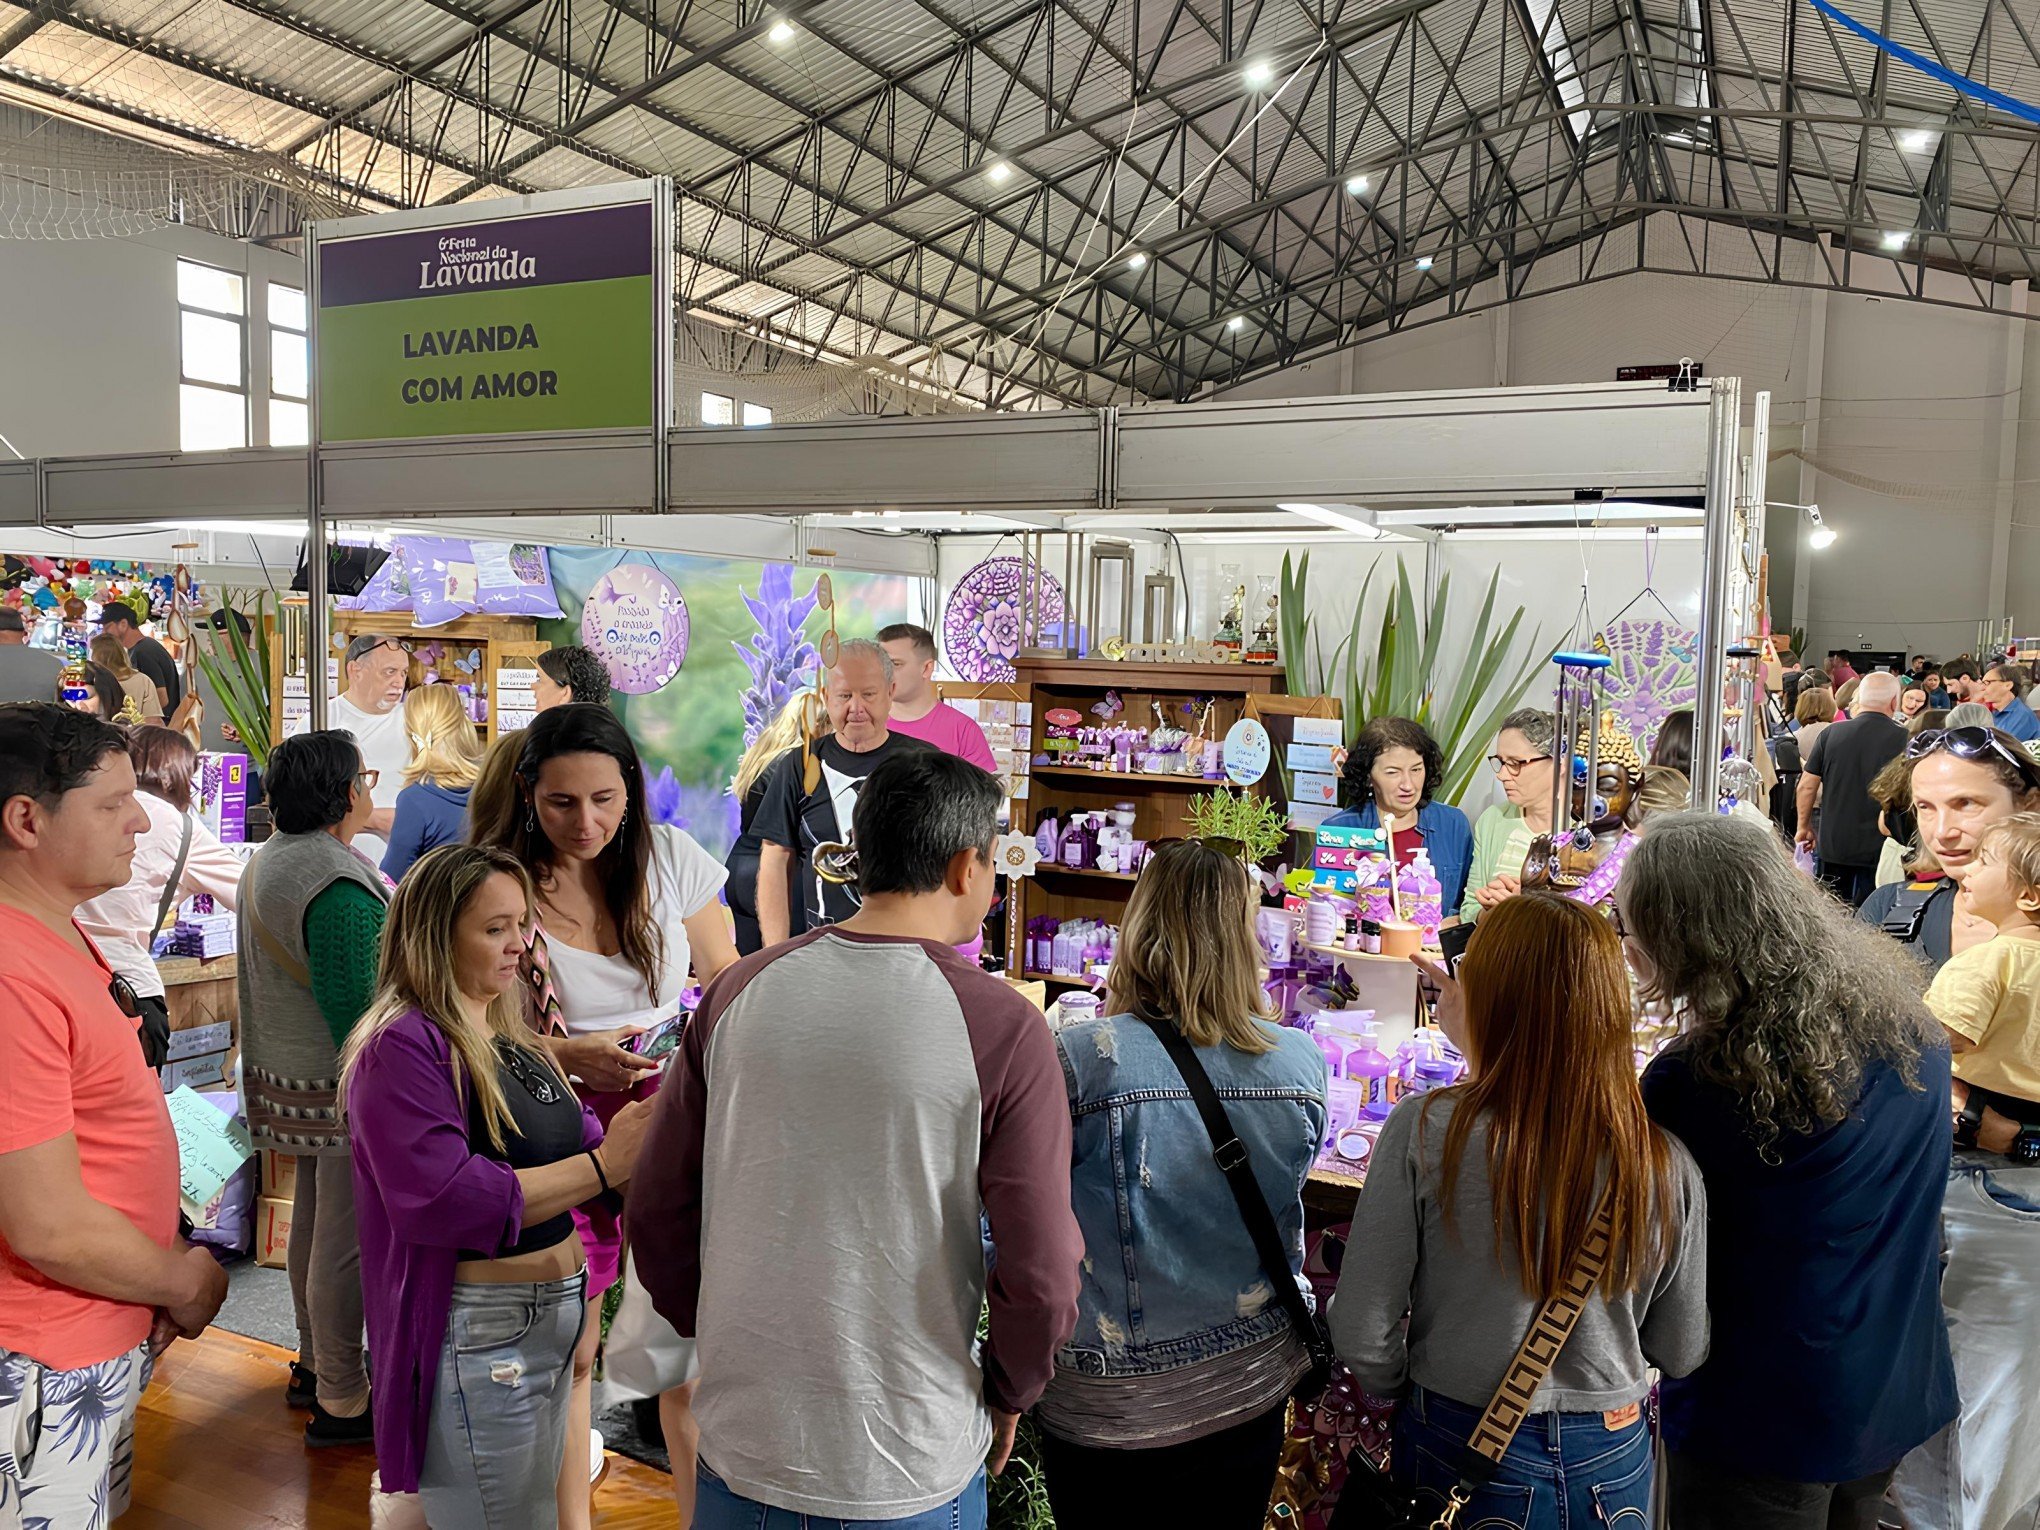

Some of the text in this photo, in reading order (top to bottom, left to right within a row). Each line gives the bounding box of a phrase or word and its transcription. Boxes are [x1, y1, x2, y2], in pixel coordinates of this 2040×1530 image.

[491, 245, 507, 259] da
[419, 250, 536, 289] Lavanda
[403, 323, 539, 358] LAVANDA
[401, 370, 558, 404] COM AMOR
